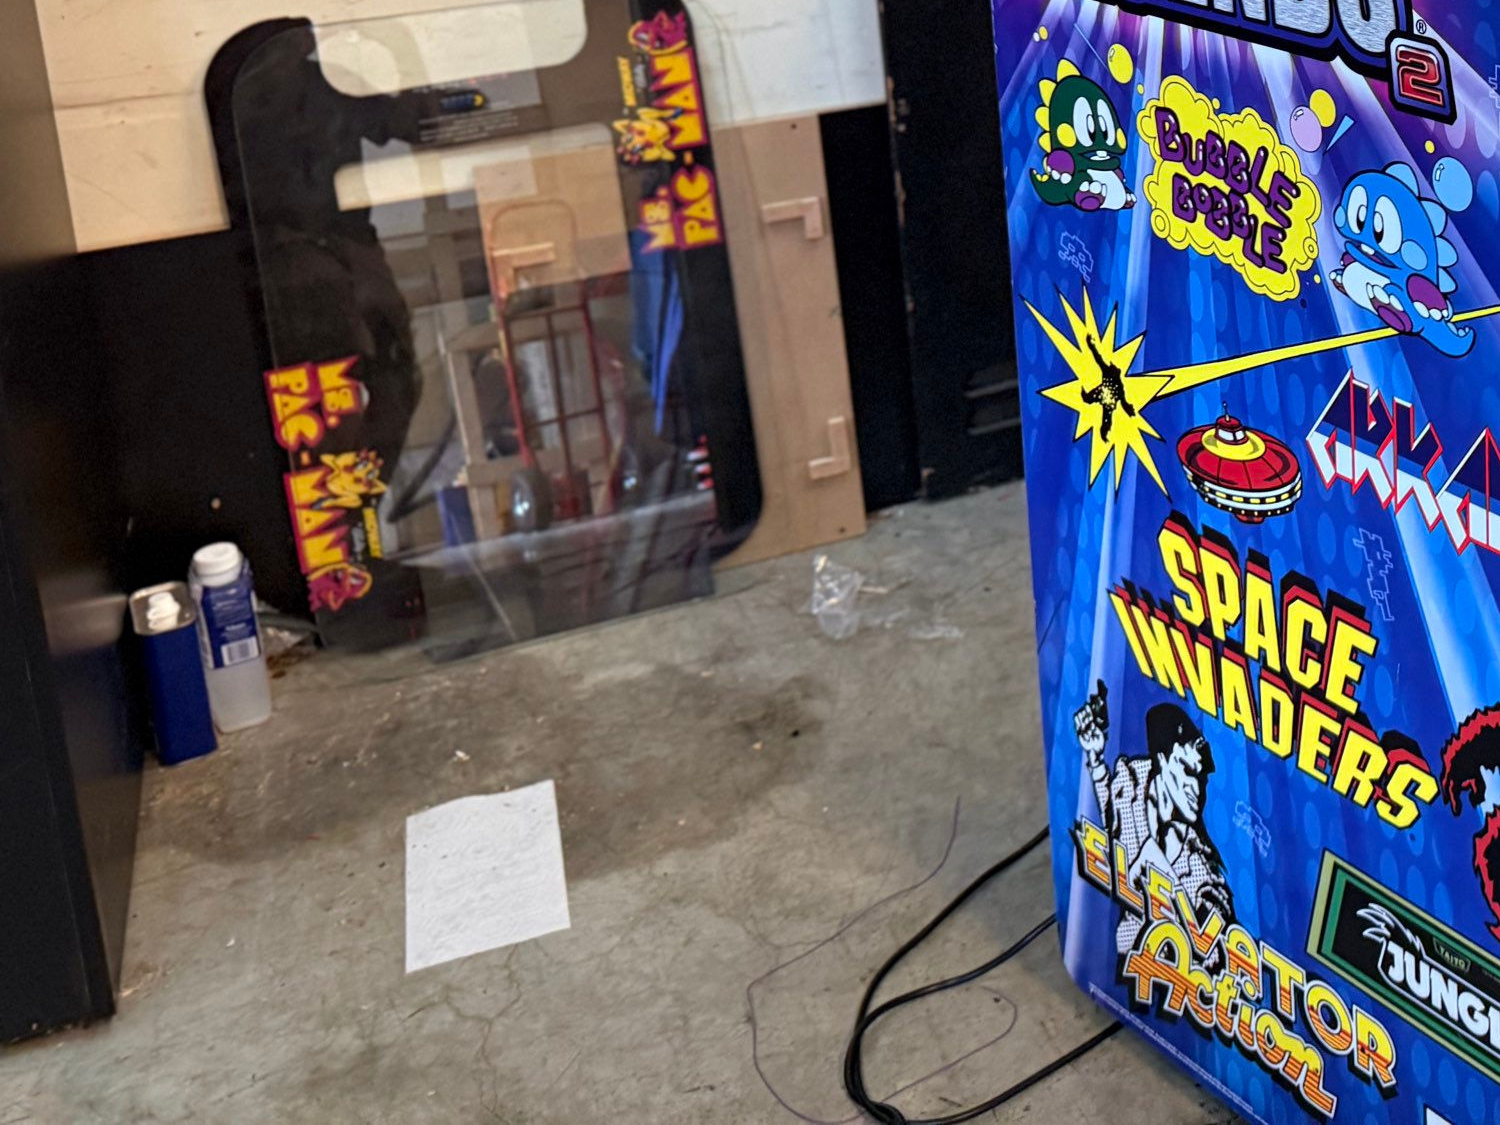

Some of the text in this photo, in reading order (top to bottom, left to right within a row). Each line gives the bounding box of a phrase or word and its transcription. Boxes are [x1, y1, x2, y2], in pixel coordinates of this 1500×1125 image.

[1154, 106, 1300, 228] BUBBLE
[1394, 40, 1449, 113] 2
[1172, 172, 1289, 275] BOBBLE
[1108, 581, 1440, 831] INVADERS
[1157, 511, 1378, 715] SPACE
[1071, 815, 1398, 1089] ELEVATOR
[1124, 919, 1338, 1119] Action
